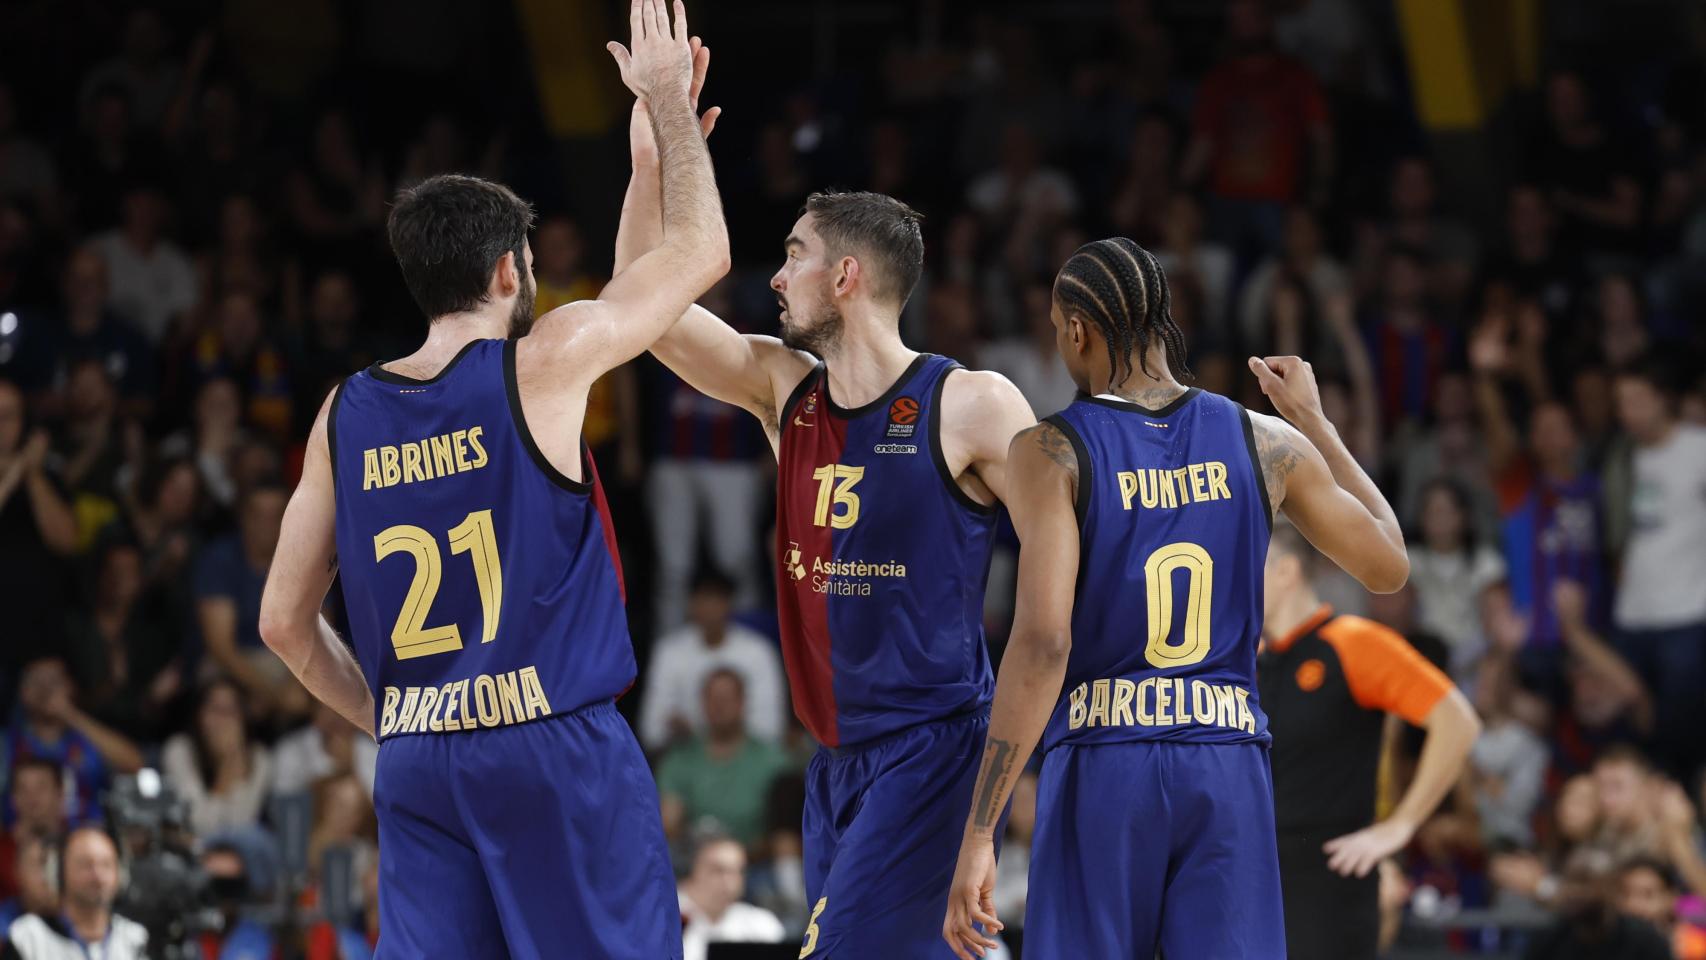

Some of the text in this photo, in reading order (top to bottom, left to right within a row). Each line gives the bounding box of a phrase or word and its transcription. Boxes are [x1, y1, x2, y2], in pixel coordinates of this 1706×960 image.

[363, 426, 488, 490] ABRINES
[874, 444, 917, 454] oneteam
[812, 464, 865, 529] 13
[1117, 461, 1231, 510] PUNTER
[373, 509, 503, 661] 21
[812, 556, 906, 577] Assistència
[812, 575, 871, 596] Sanitària
[1144, 542, 1213, 669] 0
[380, 666, 551, 737] BARCELONA
[1068, 677, 1255, 734] BARCELONA
